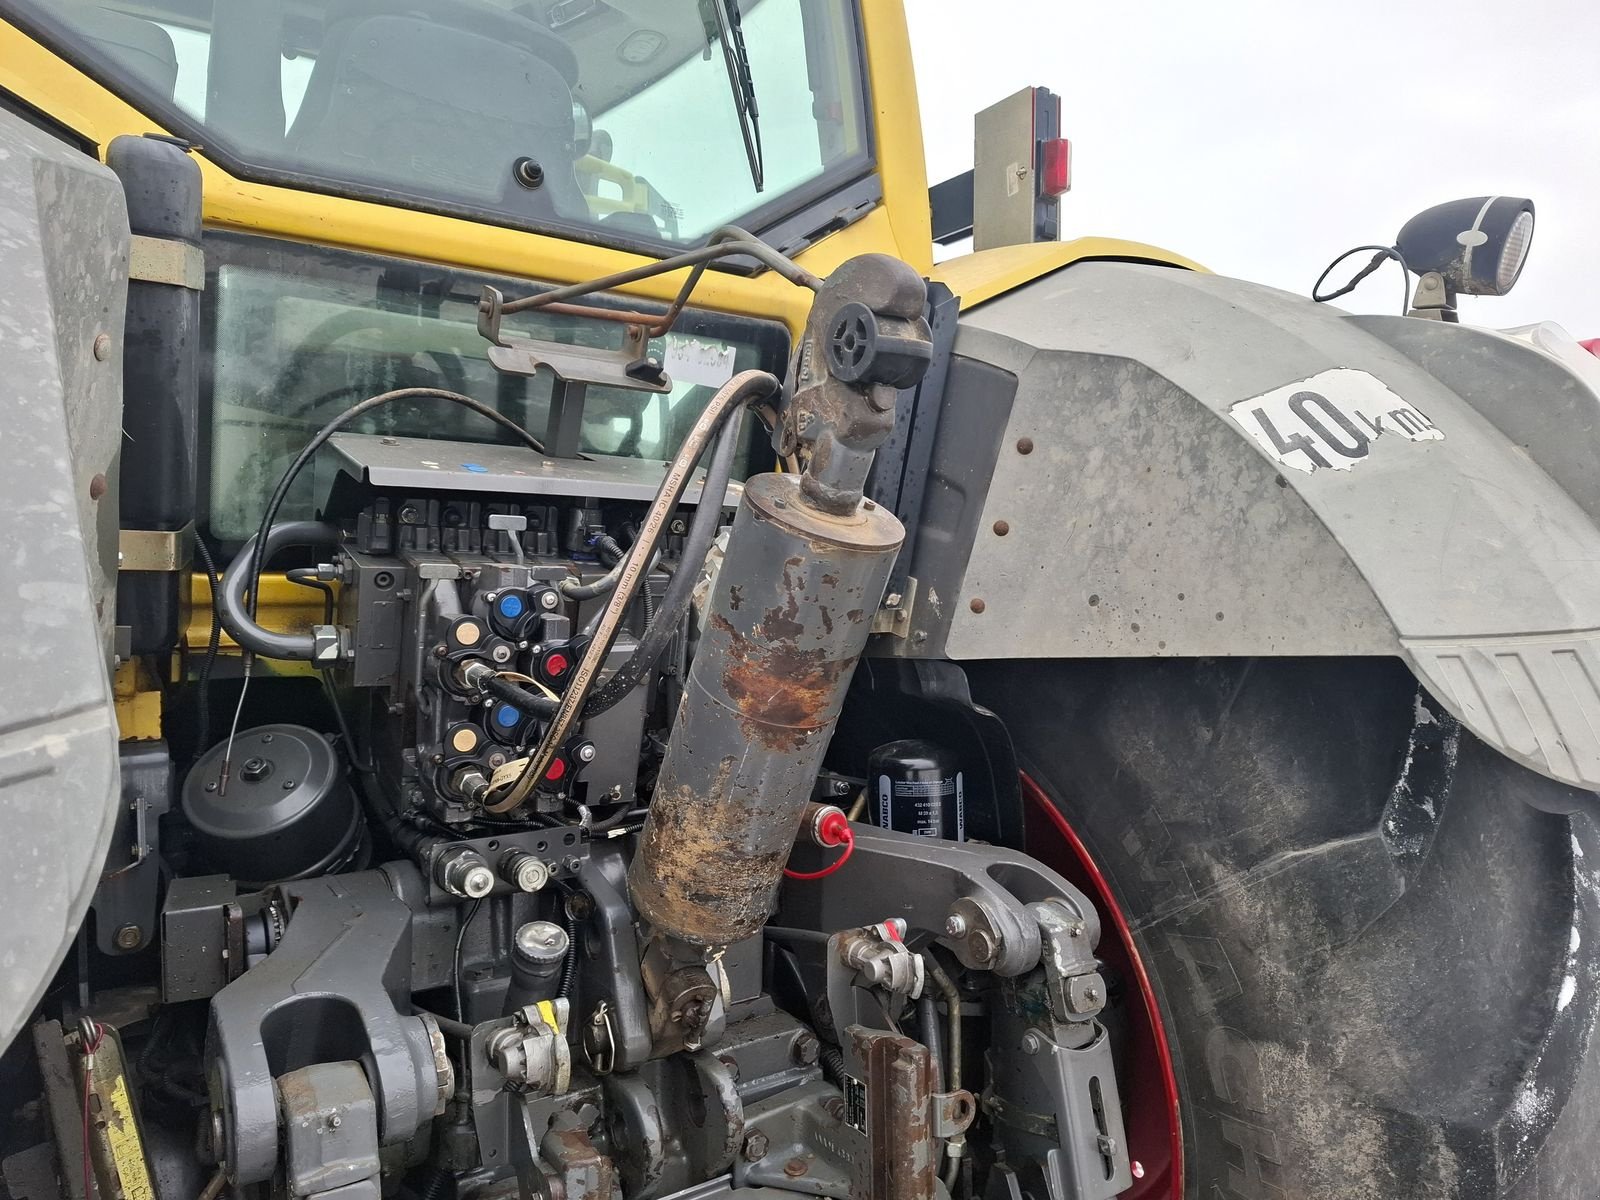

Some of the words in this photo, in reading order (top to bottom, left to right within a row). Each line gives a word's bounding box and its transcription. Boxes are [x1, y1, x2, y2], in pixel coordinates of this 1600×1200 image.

[1251, 390, 1369, 469] 40
[1354, 408, 1433, 439] km
[663, 472, 680, 498] MSHA
[647, 510, 662, 534] 40/26
[622, 572, 633, 590] mm
